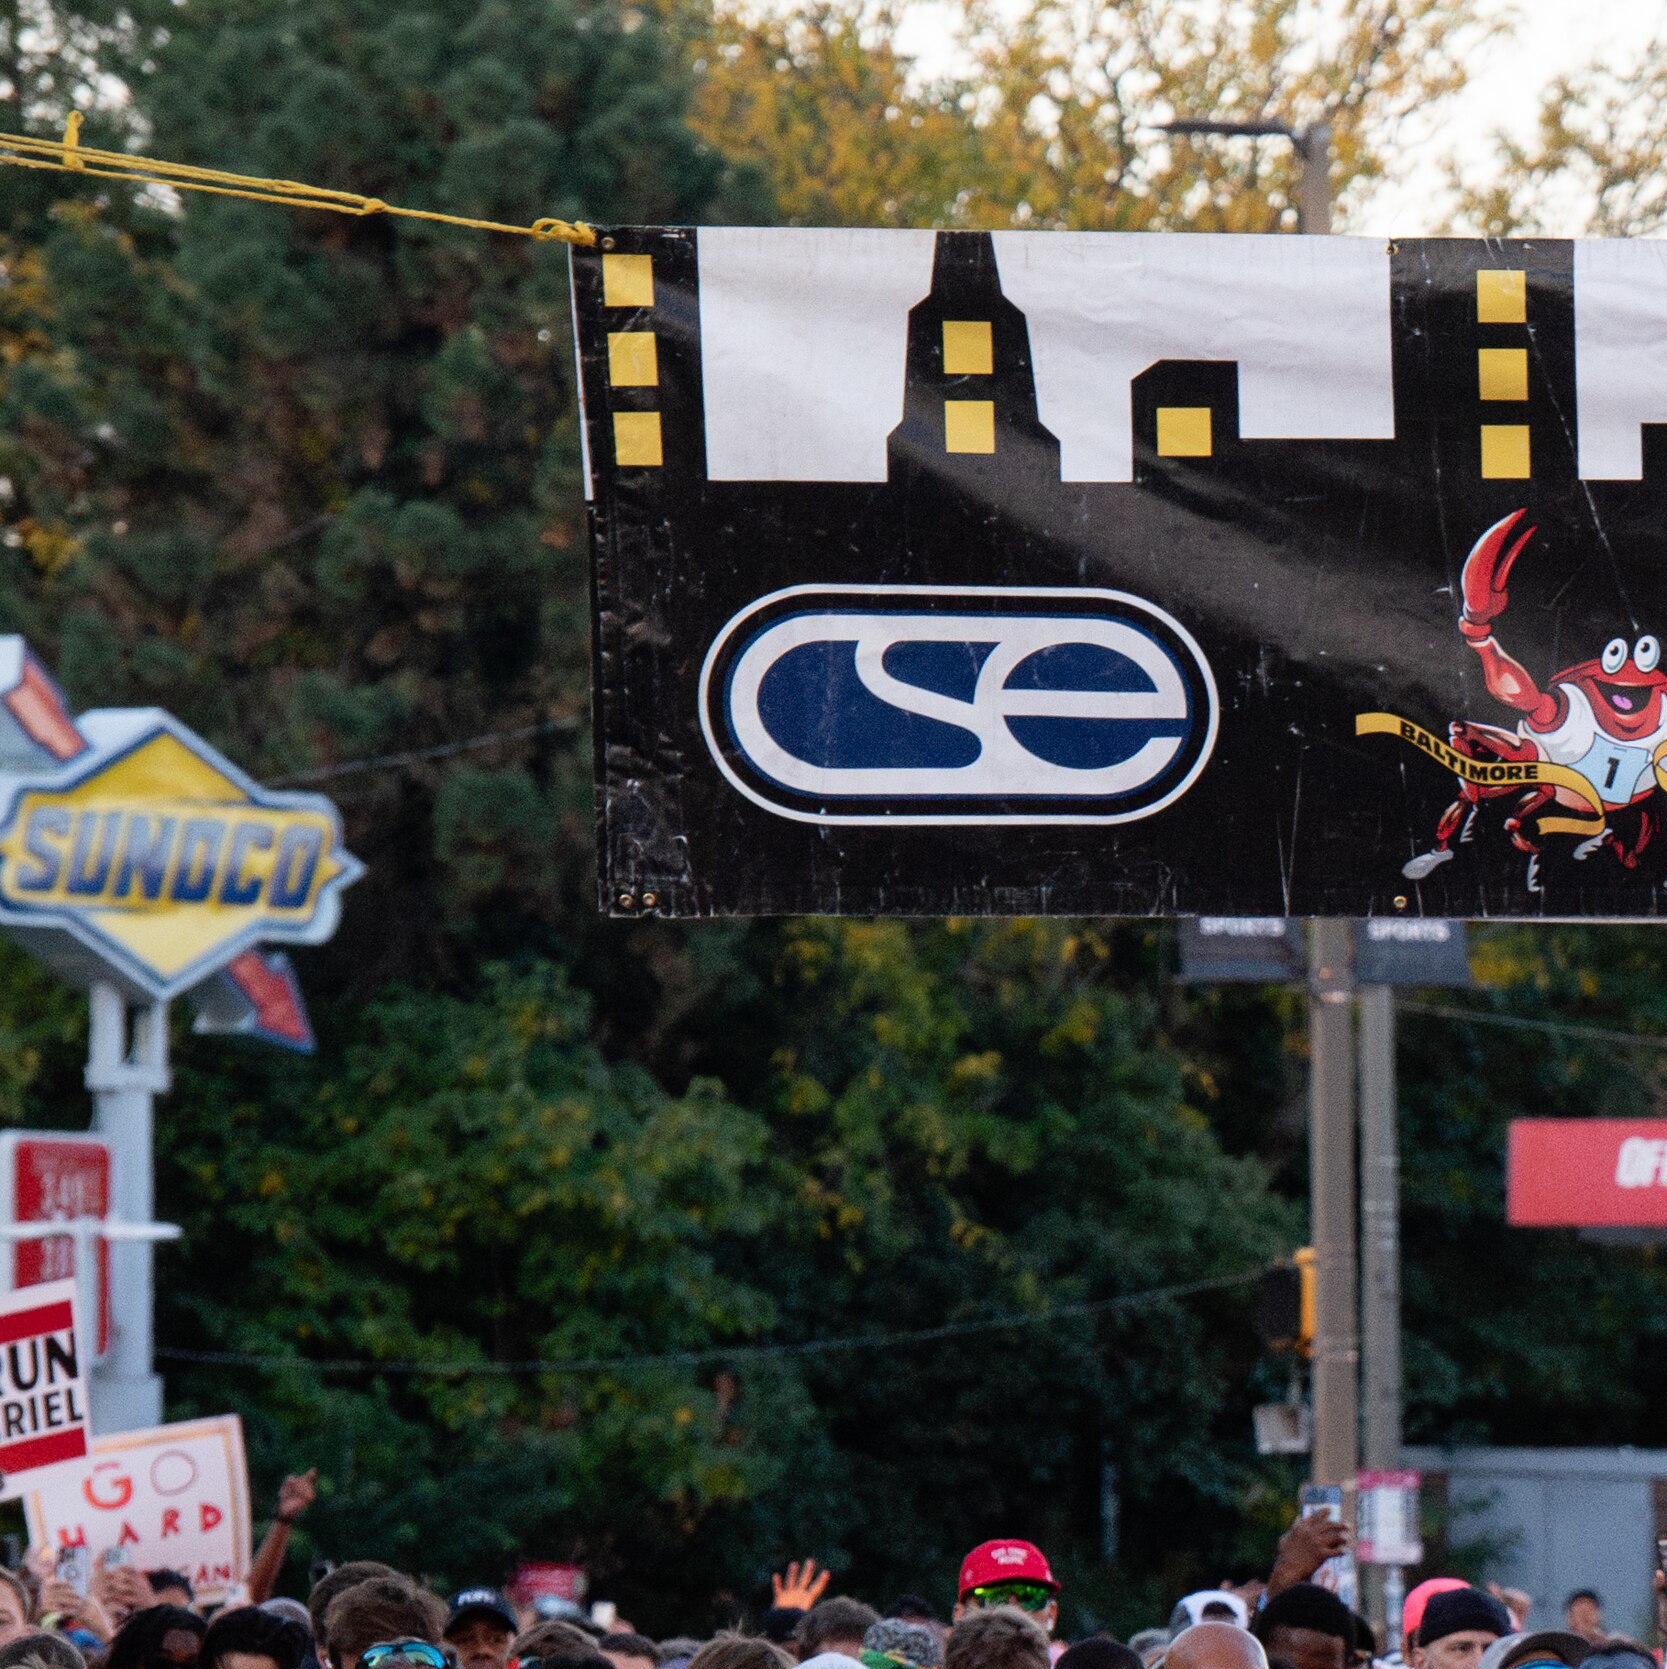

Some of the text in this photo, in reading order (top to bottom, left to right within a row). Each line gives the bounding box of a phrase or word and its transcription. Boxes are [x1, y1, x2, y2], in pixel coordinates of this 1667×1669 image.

[1400, 721, 1540, 783] BALTIMORE
[1602, 756, 1619, 789] 1
[16, 803, 324, 910] SUNOCO
[0, 1330, 79, 1394] UN
[82, 1449, 196, 1512] GO
